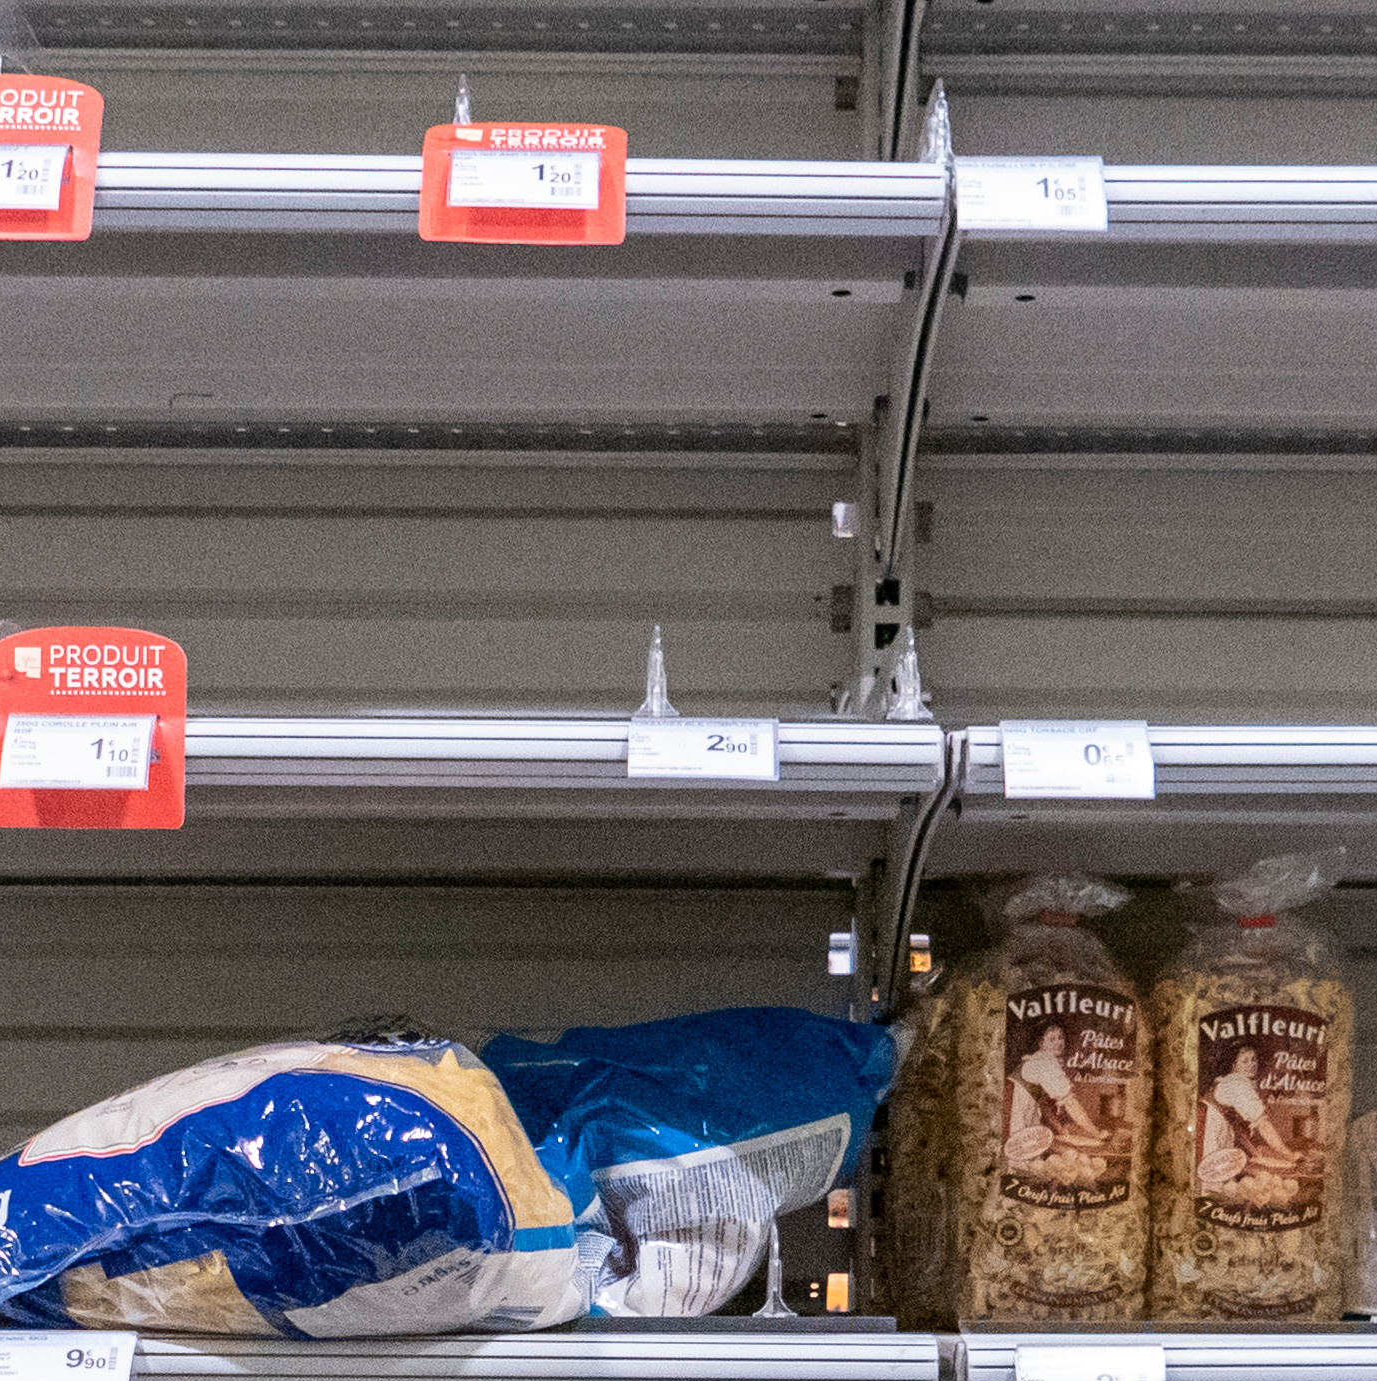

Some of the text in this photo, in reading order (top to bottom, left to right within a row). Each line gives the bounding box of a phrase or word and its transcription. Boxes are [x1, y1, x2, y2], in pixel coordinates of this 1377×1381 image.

[490, 129, 606, 138] PRODUIT
[490, 137, 606, 147] TERROIR
[49, 645, 166, 667] PRODUIT
[48, 668, 164, 690] TERROIR
[1008, 991, 1134, 1024] Valfleuri
[1200, 1012, 1326, 1044] Valfleuri
[1081, 1030, 1124, 1050] Pâtes
[1066, 1052, 1135, 1072] d'Alsace
[1274, 1051, 1318, 1070] Pâtes
[1259, 1071, 1327, 1092] d'Alsace
